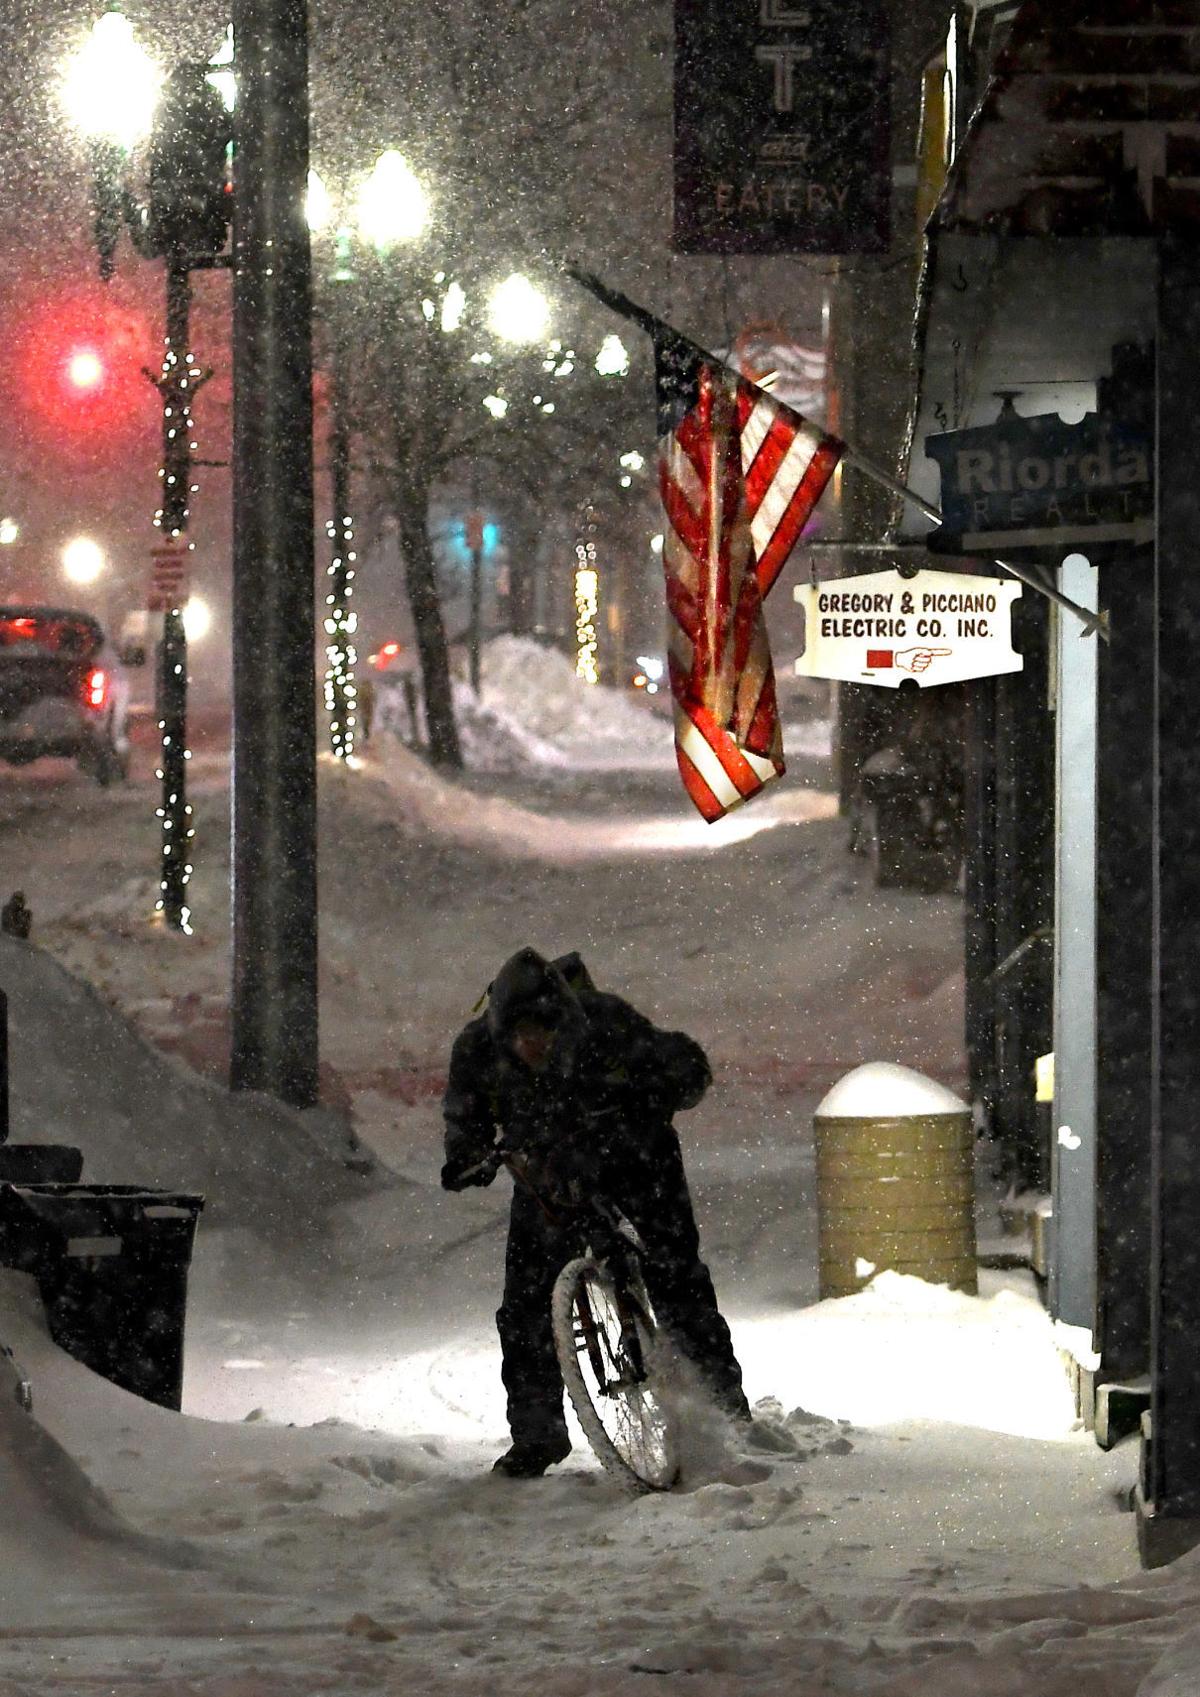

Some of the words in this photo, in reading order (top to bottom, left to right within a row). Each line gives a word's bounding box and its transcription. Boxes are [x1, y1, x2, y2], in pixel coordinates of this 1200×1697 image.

[715, 181, 850, 213] EATERY
[818, 593, 894, 614] GREGORY
[900, 591, 915, 615] &
[922, 593, 997, 614] PICCIANO
[821, 618, 907, 638] ELECTRIC
[916, 618, 947, 638] CO.
[957, 618, 994, 638] INC.
